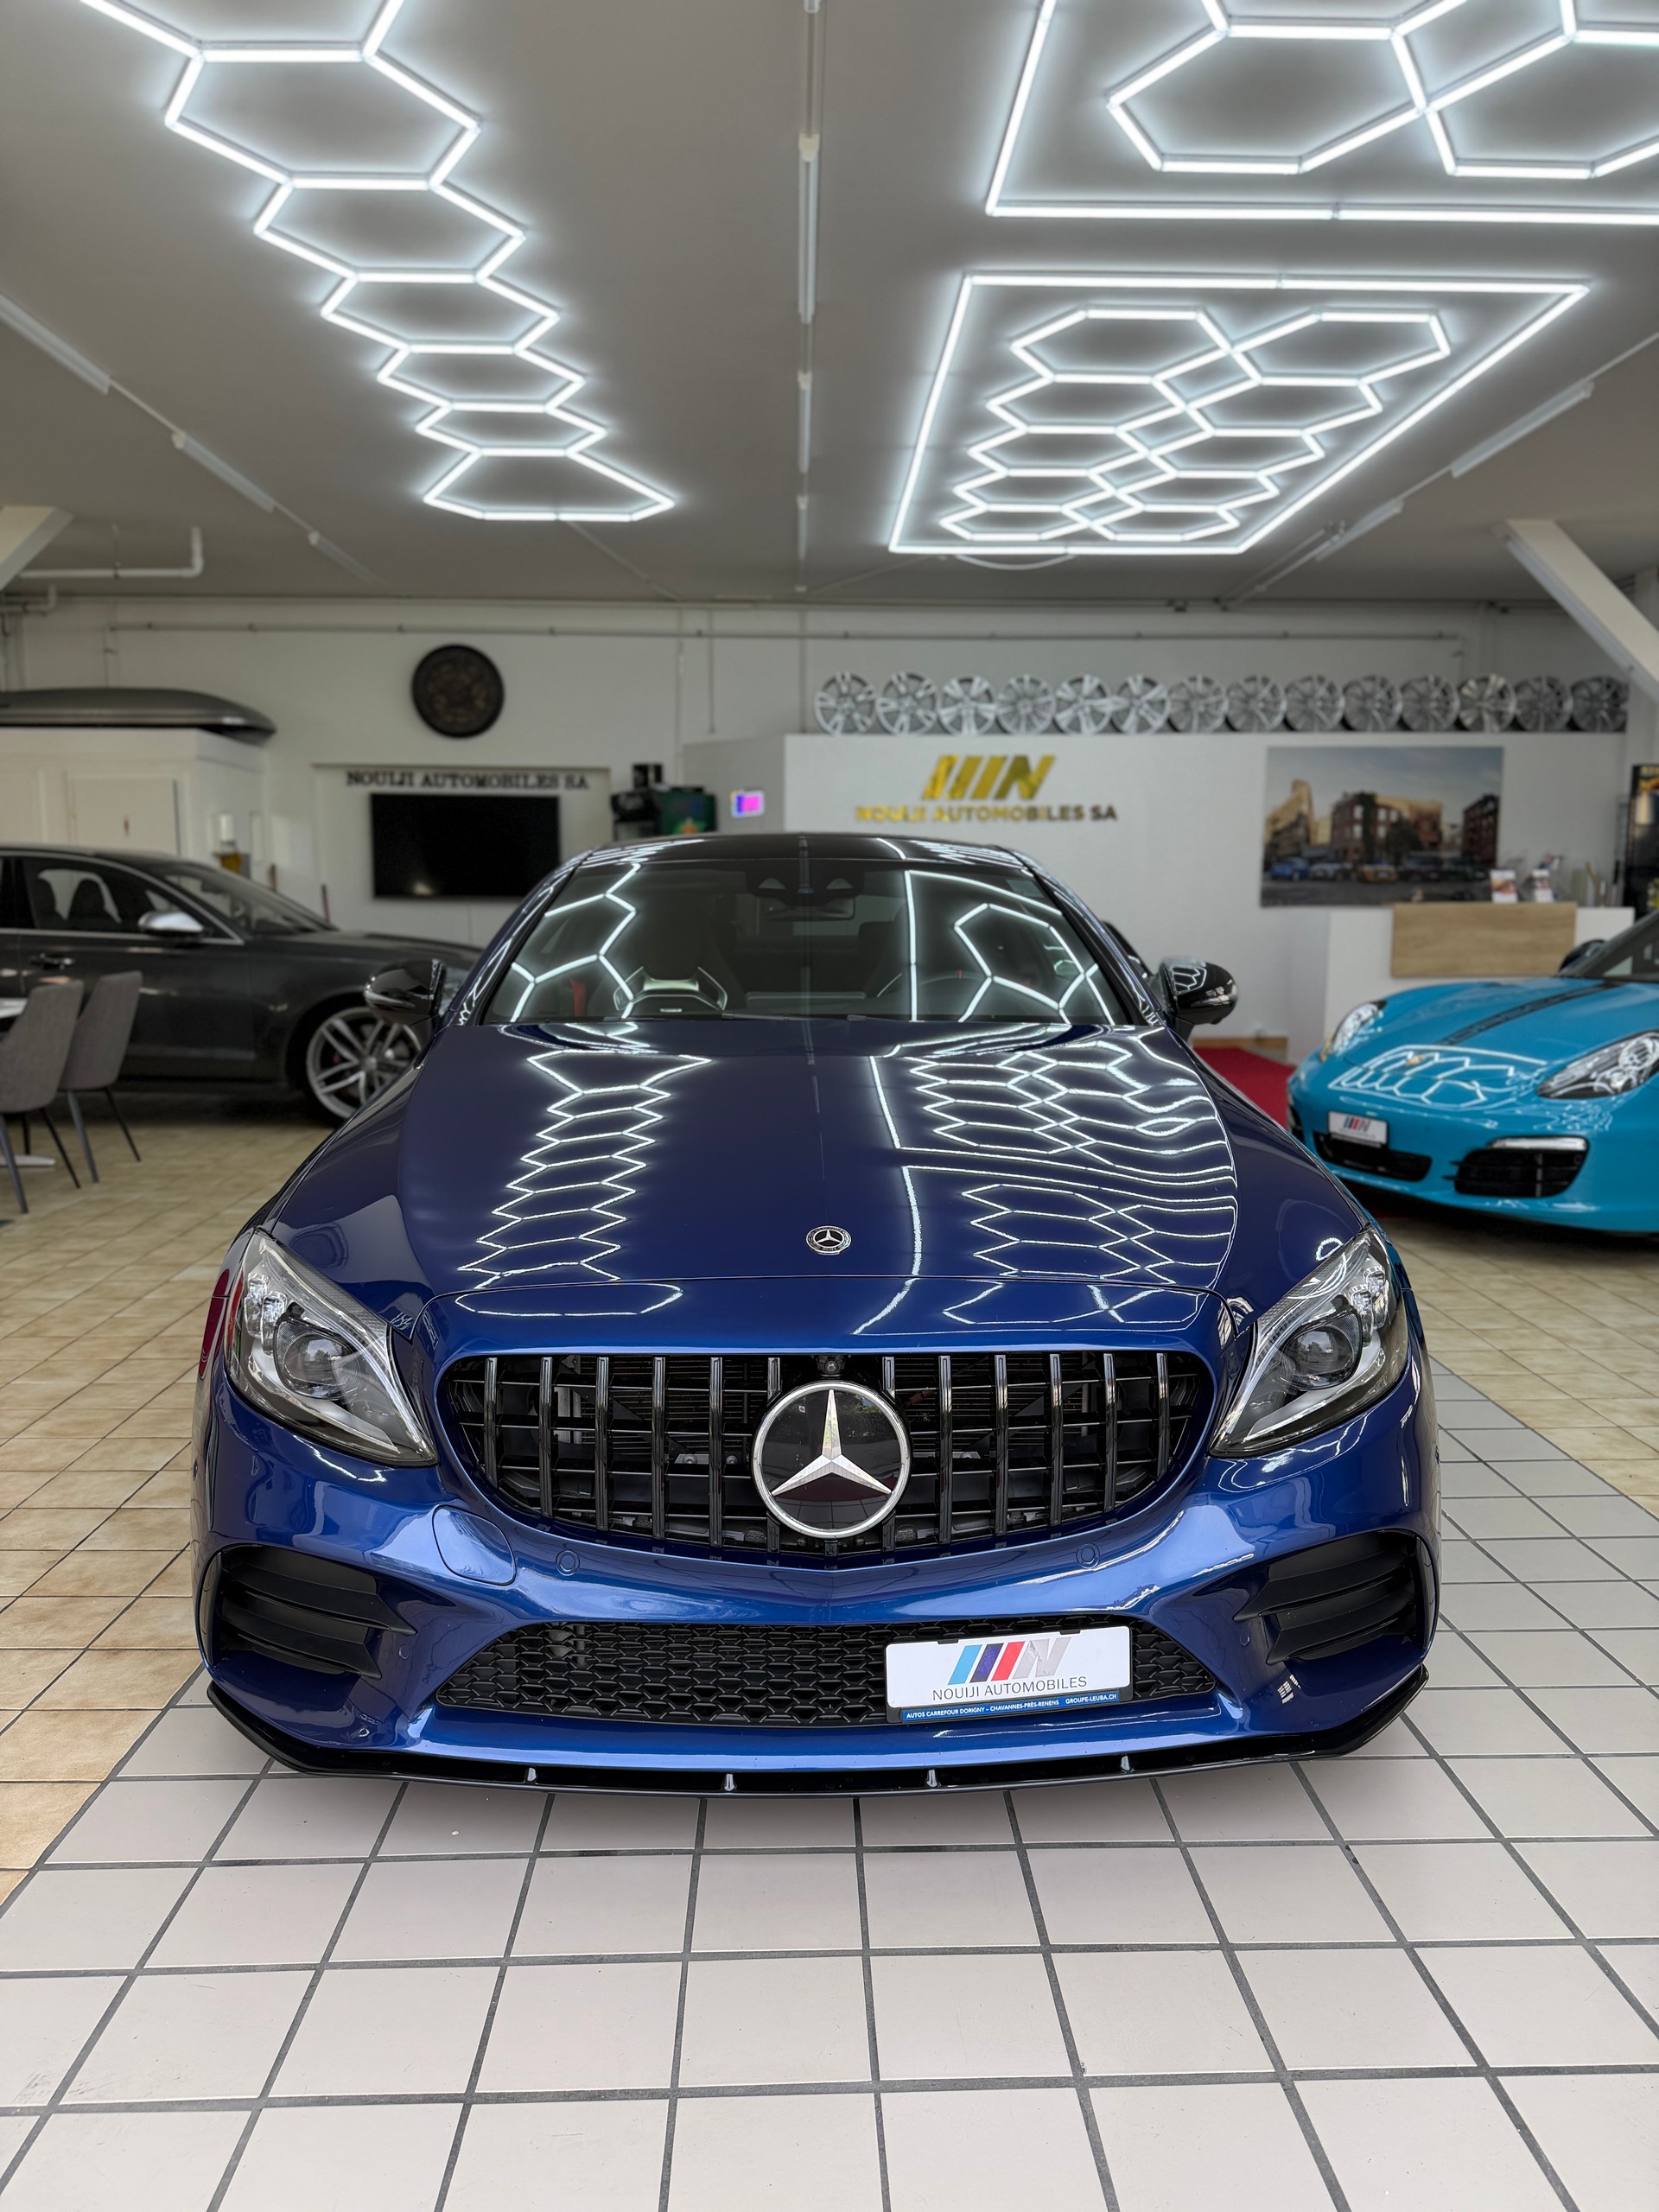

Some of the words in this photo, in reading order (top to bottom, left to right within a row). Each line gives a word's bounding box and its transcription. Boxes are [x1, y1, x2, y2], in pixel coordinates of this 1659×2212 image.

[421, 772, 559, 790] AUTOMOBILES
[564, 774, 589, 790] SA
[934, 804, 1084, 822] AUTOMOBILES
[1090, 804, 1117, 821] SA
[932, 1686, 979, 1701] NOUIJI
[984, 1676, 1088, 1696] AUTOMOBILES
[1065, 1694, 1117, 1705] GROUPE-LEUBA.CH
